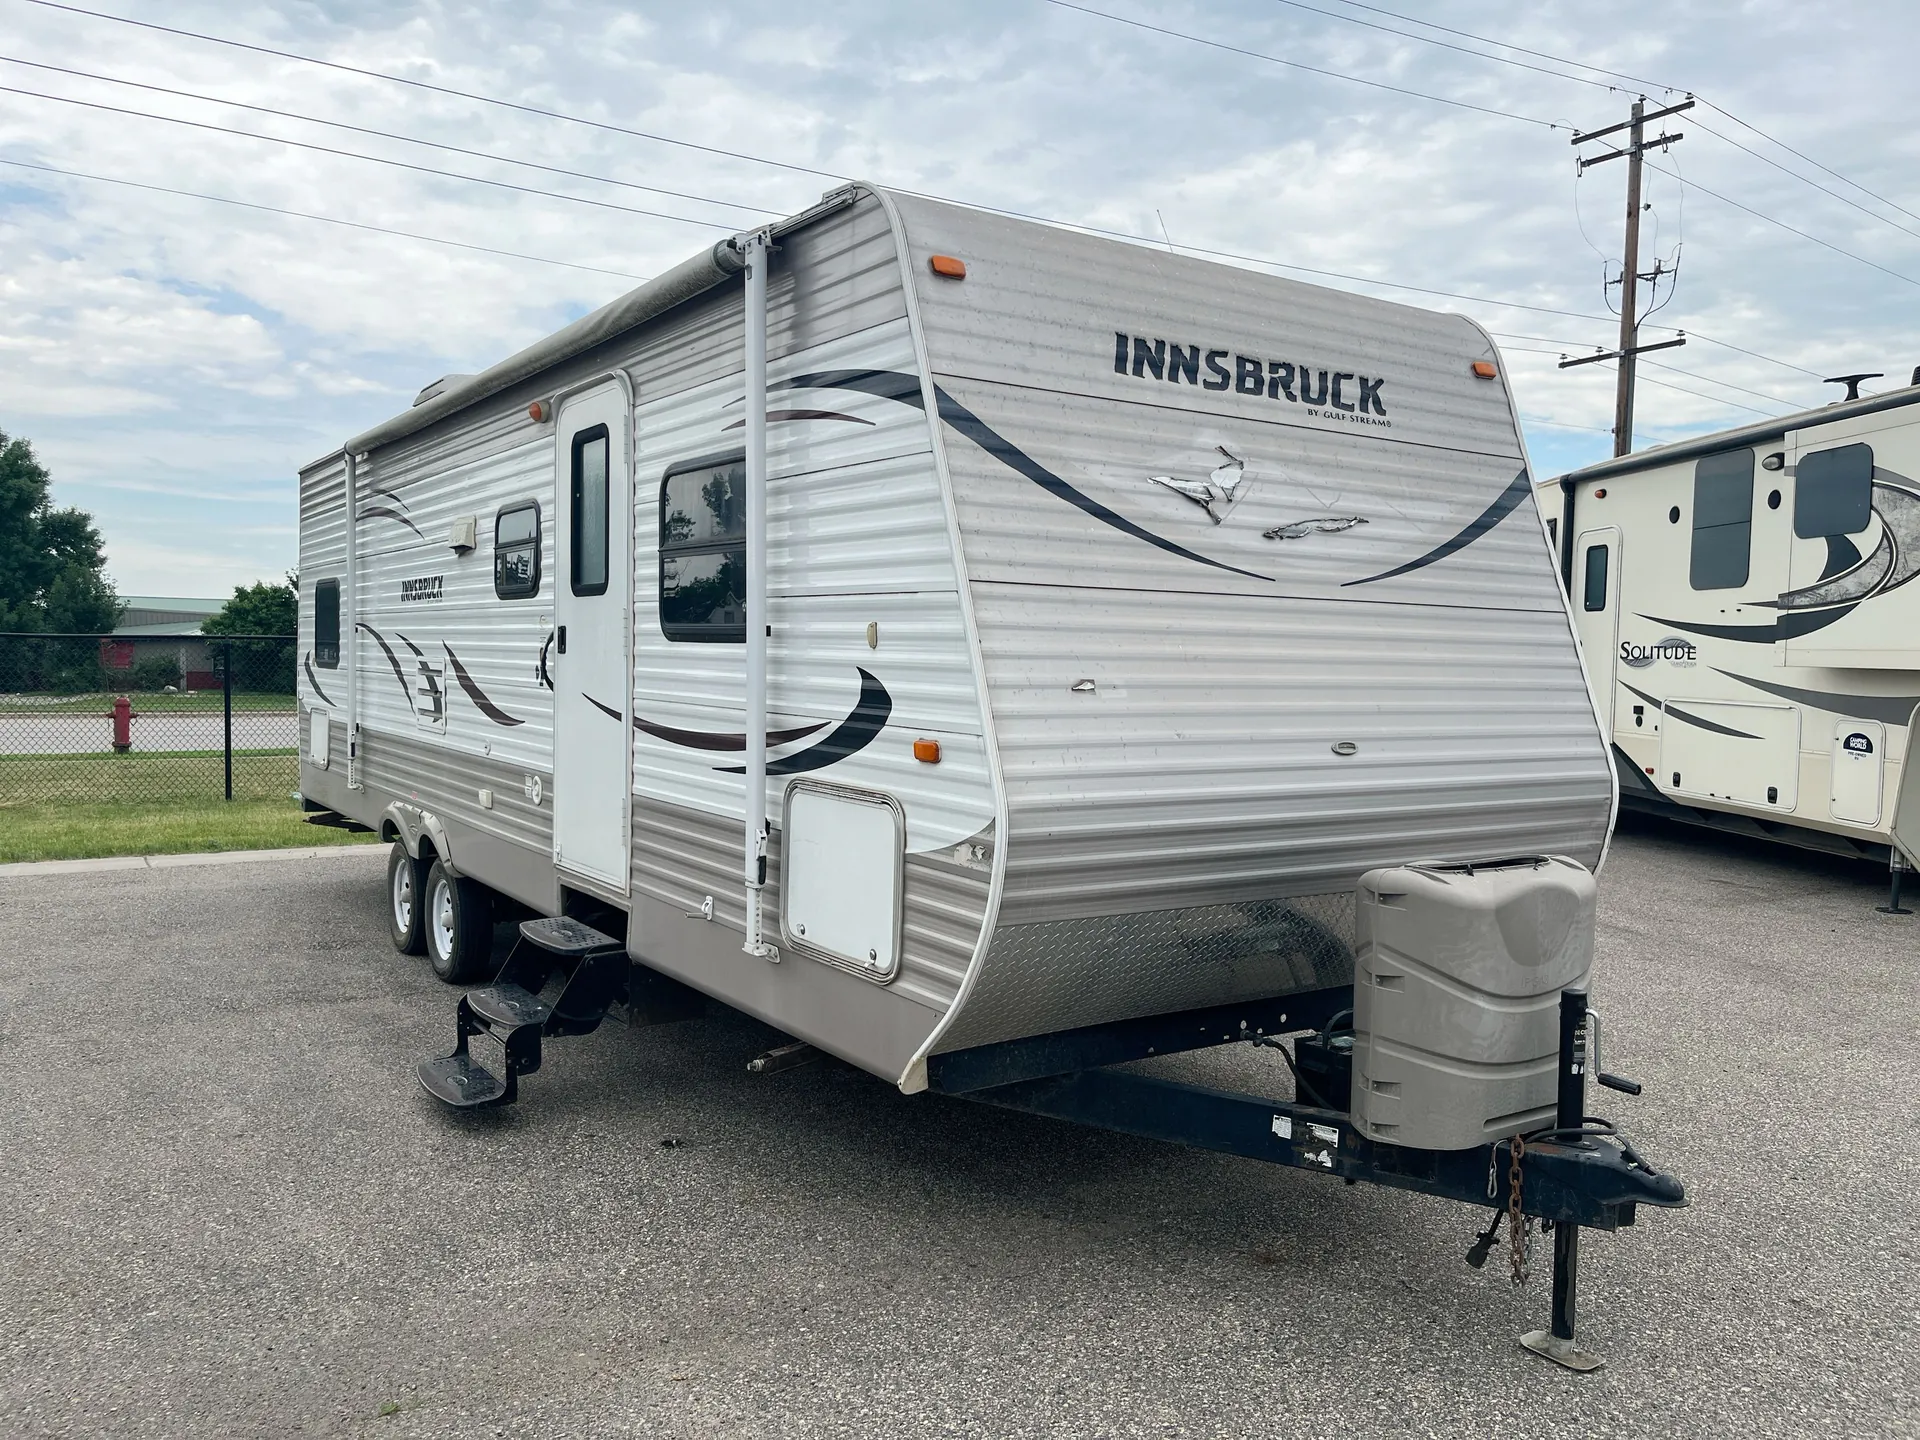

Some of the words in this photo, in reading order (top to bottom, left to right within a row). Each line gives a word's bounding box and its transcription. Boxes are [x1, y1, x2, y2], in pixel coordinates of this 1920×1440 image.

[1114, 332, 1387, 416] INNSBRUCK
[1307, 408, 1319, 416] BY
[1323, 410, 1346, 421] GULF
[401, 575, 444, 602] INNSBRUCK
[1620, 641, 1697, 661] SOLITUDE
